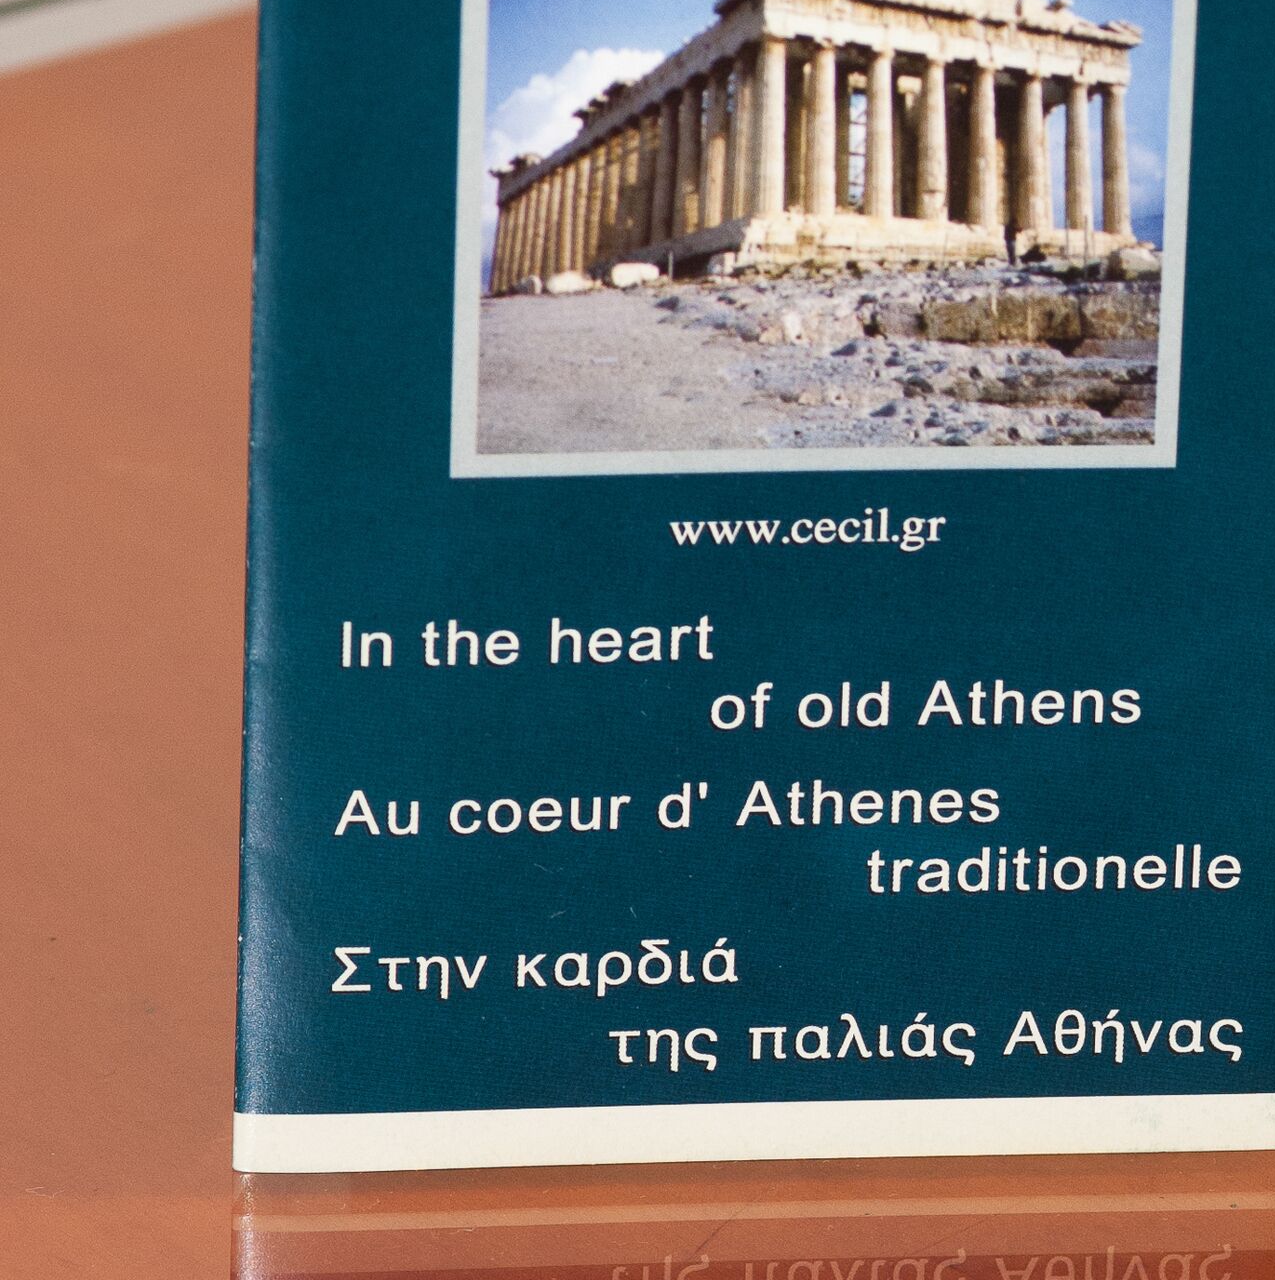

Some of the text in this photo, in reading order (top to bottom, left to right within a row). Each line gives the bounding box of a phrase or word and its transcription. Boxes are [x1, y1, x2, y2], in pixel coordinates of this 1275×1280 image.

[669, 508, 946, 553] www.cecil.gr
[340, 616, 715, 668] In the heart
[710, 680, 1142, 731] of old Athens
[335, 780, 1001, 837] Au coeur d' Athenes
[867, 845, 1243, 894] traditionelle
[332, 938, 740, 1001] Στην καρδιά
[608, 1010, 1244, 1074] της παλιάς Αθήνας
